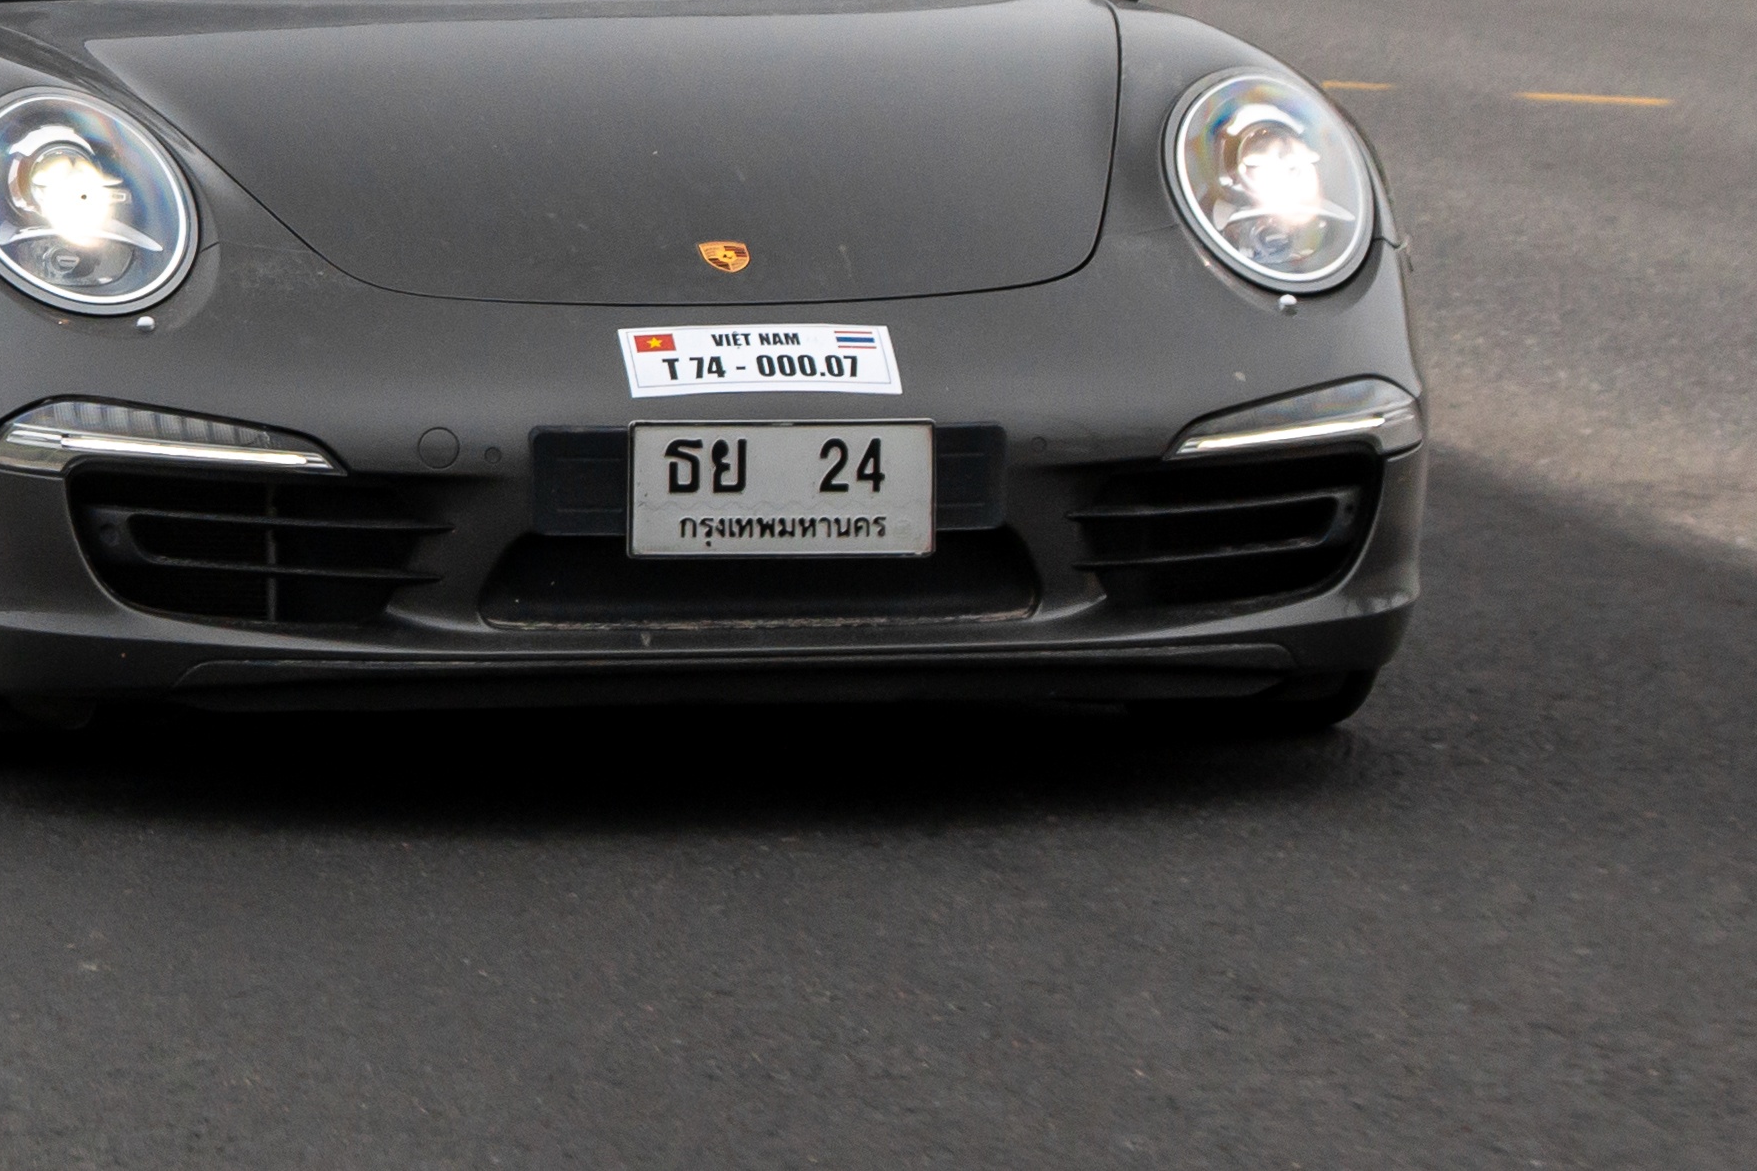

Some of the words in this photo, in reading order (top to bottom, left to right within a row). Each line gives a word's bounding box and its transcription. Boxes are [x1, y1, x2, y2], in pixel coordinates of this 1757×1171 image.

[710, 331, 752, 348] VIỆT
[759, 332, 801, 347] NAM
[661, 358, 681, 381] T
[689, 356, 727, 379] 74
[756, 354, 859, 378] 000.07
[664, 438, 748, 493] ธย
[818, 437, 886, 492] 24
[679, 513, 887, 548] กรุงเทพมหานคร
